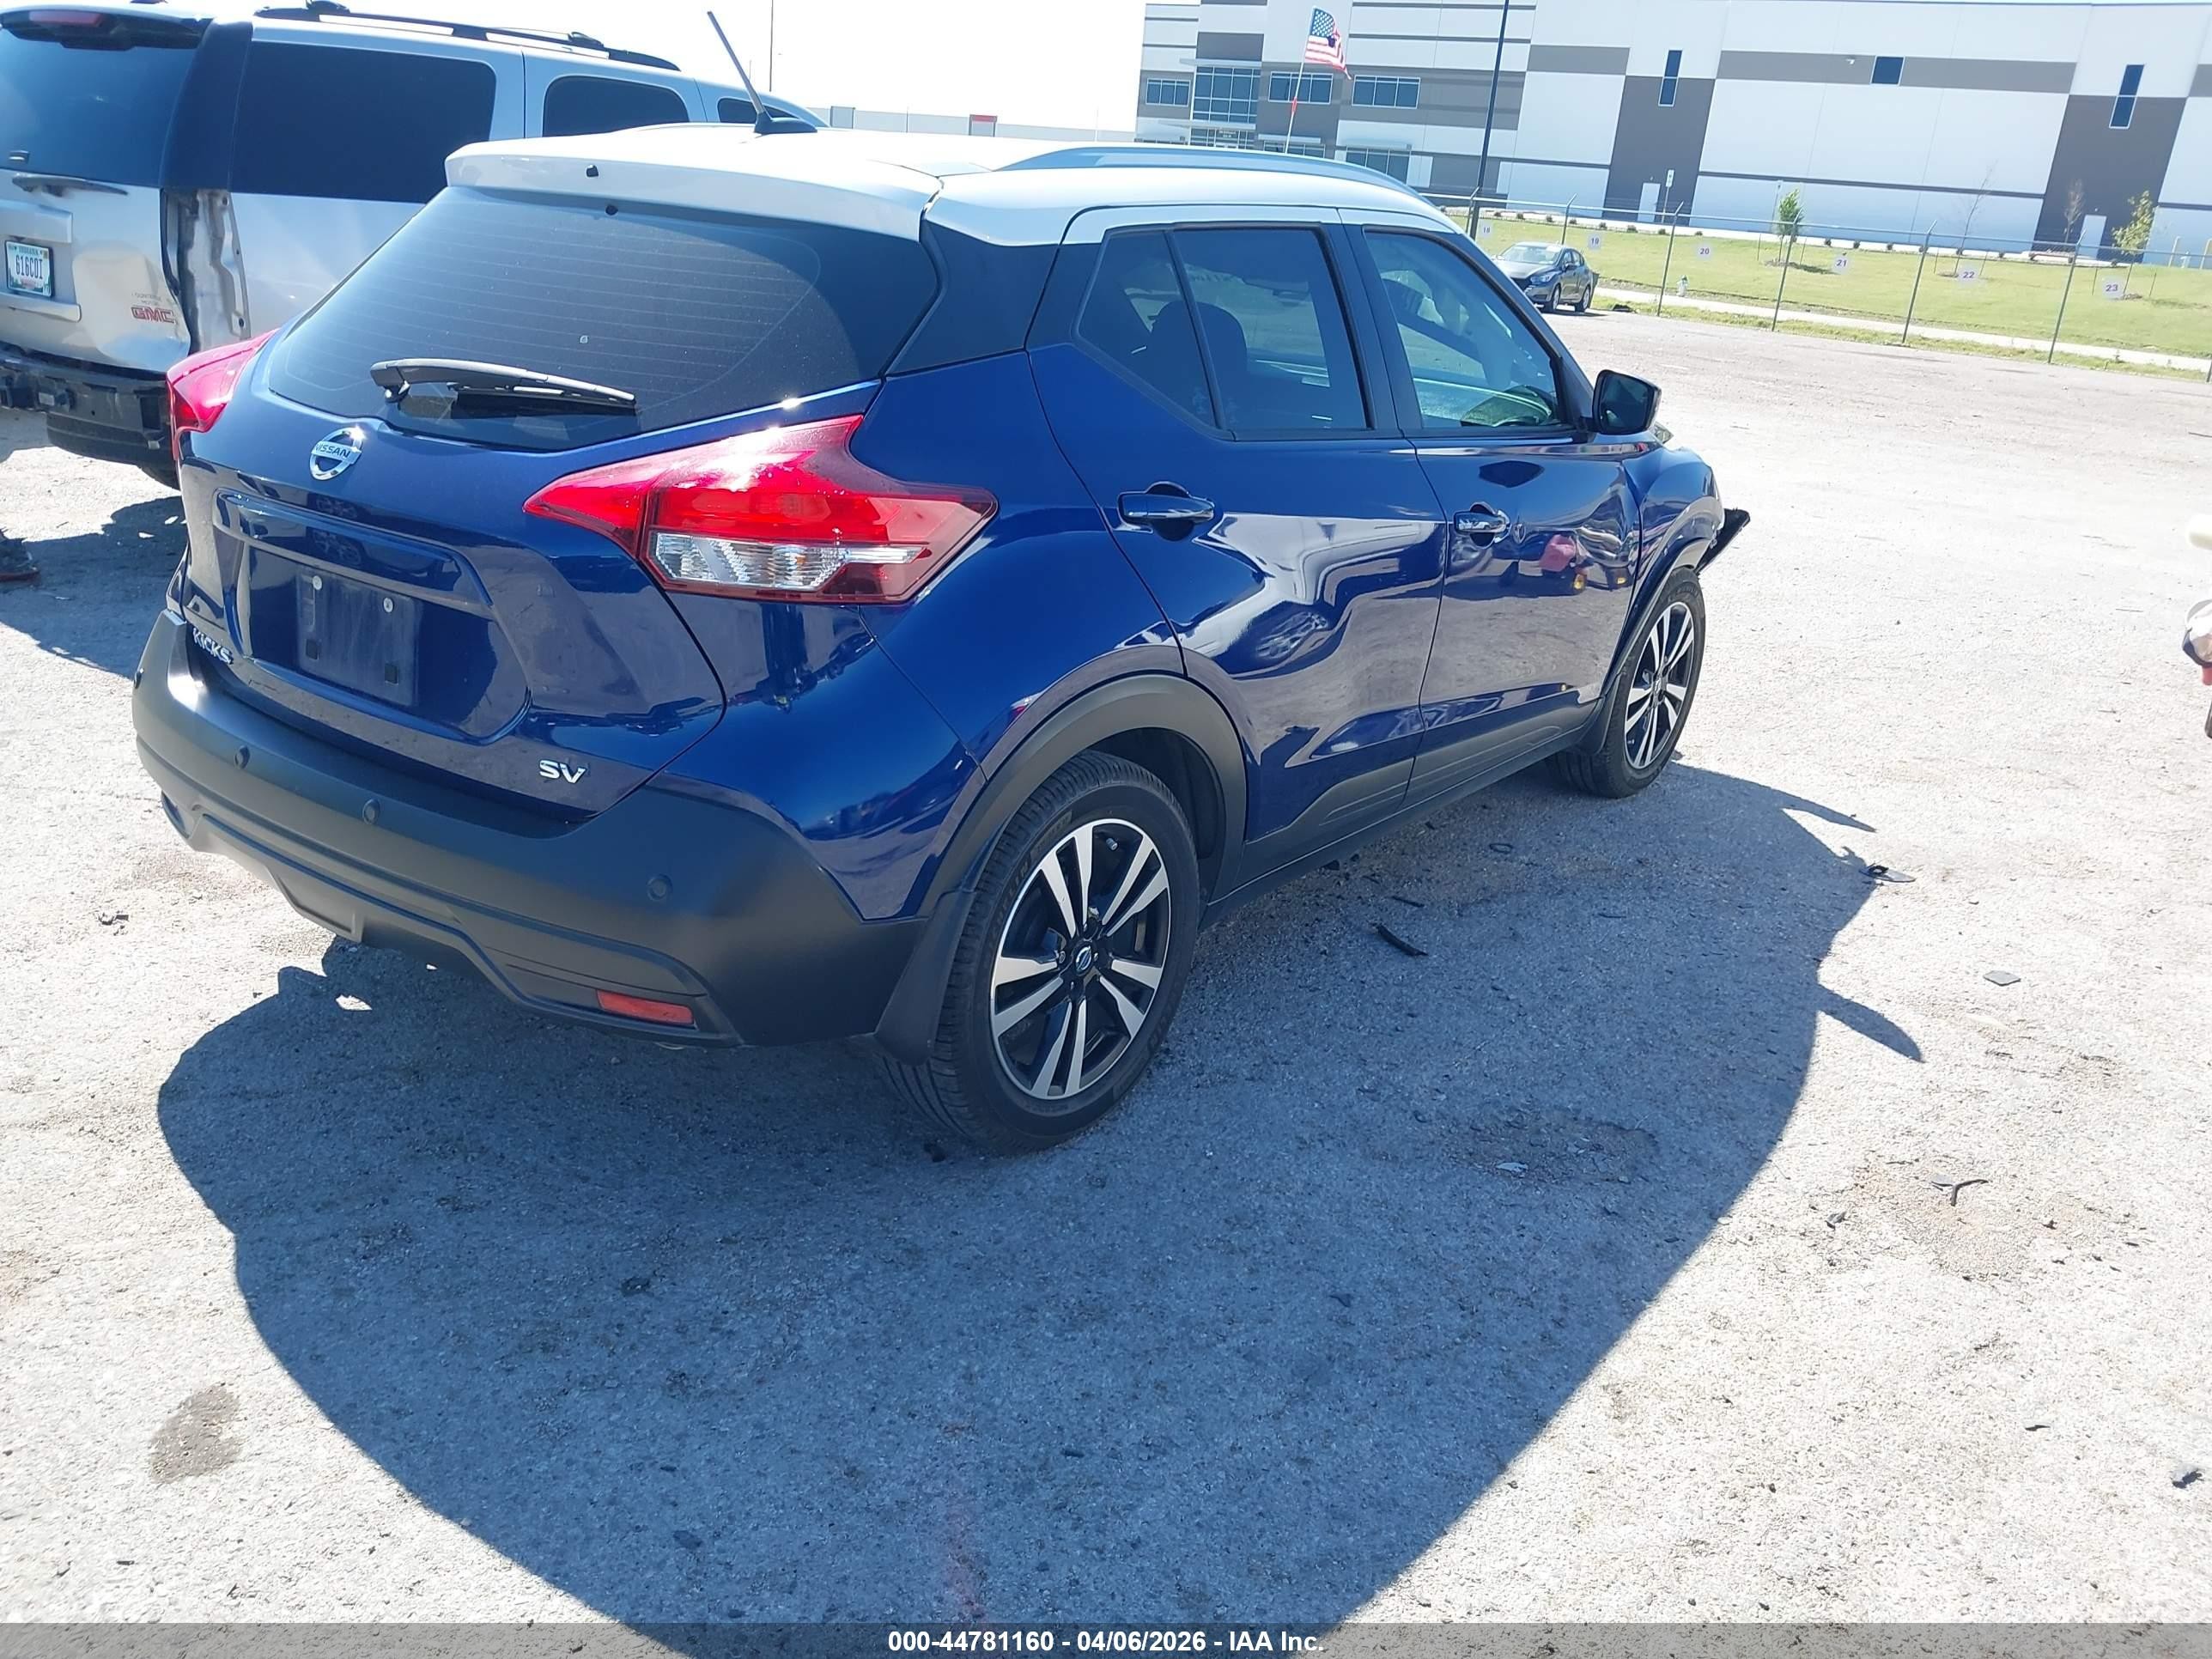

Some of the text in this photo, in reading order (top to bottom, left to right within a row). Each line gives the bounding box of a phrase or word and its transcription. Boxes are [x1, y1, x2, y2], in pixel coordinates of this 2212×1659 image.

[1963, 270, 1975, 279] 22
[2106, 283, 2118, 292] 23
[131, 305, 175, 324] GMC
[315, 443, 351, 459] NISSAN
[192, 627, 232, 665] KICKS
[538, 759, 586, 784] SV
